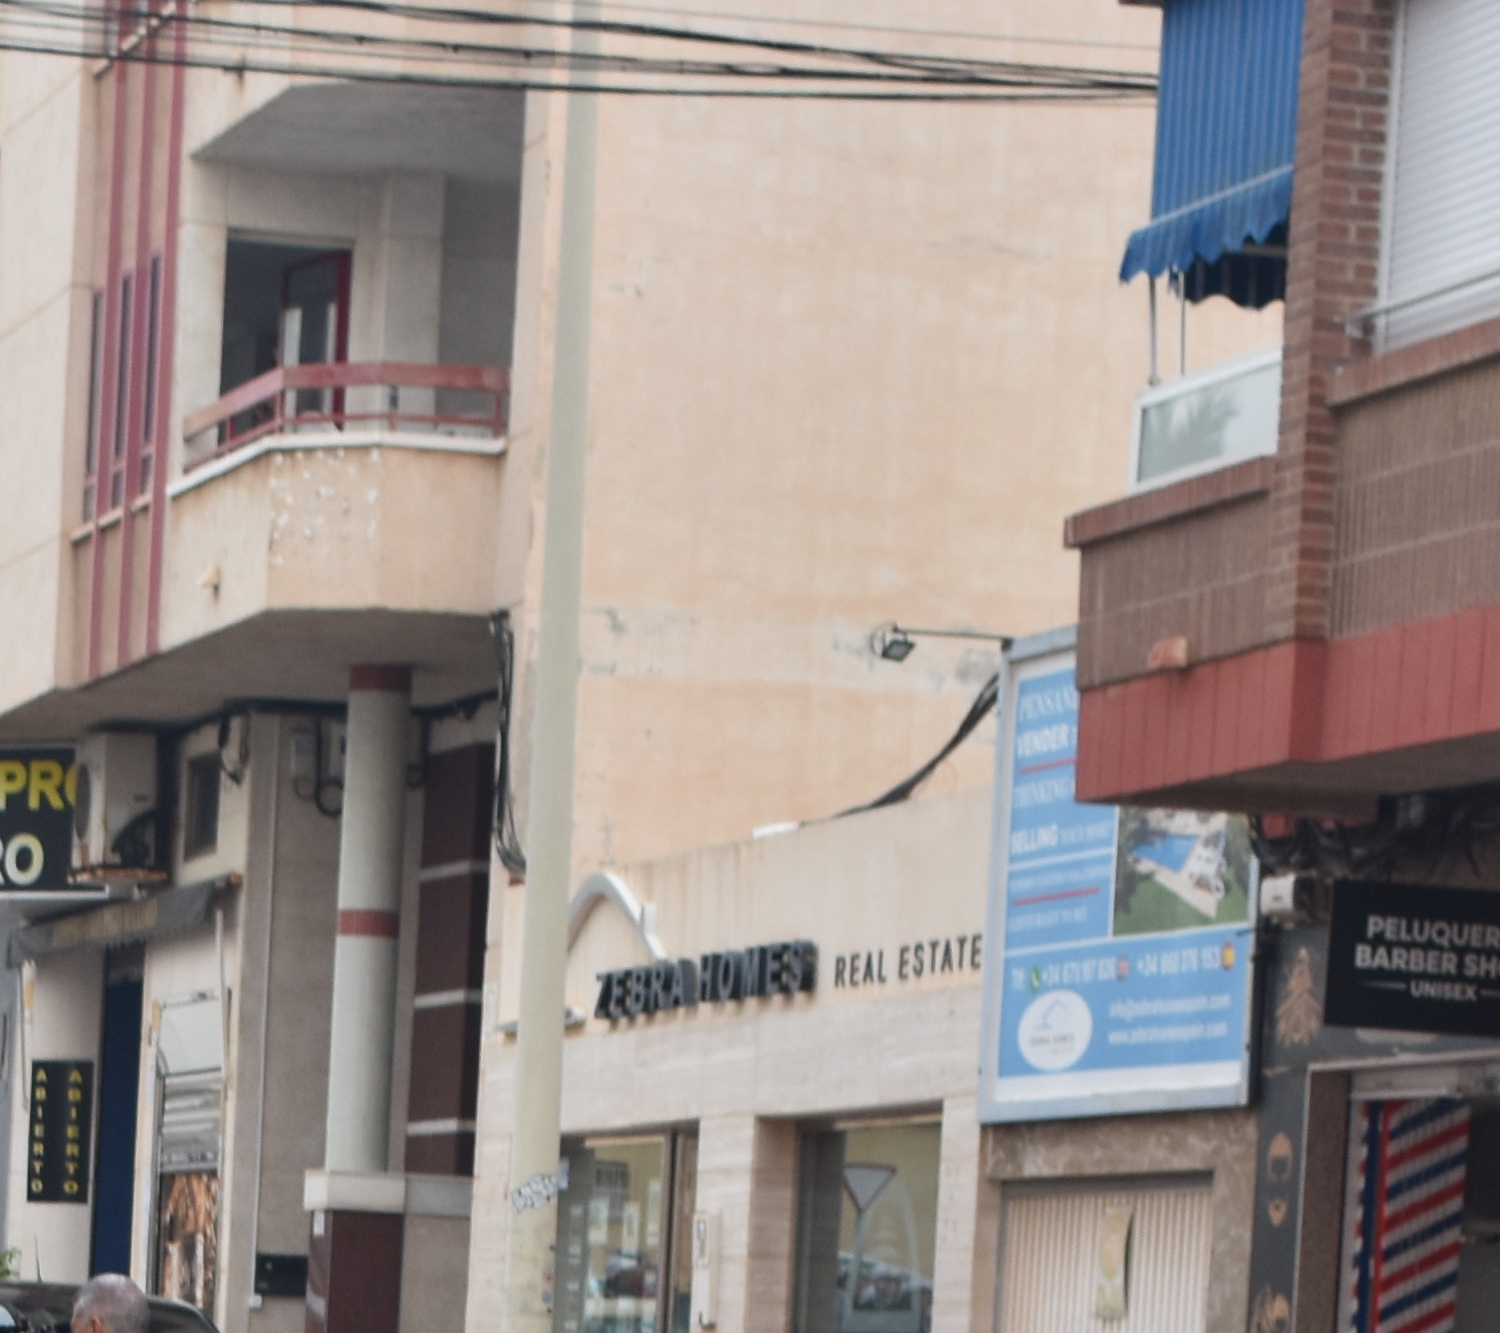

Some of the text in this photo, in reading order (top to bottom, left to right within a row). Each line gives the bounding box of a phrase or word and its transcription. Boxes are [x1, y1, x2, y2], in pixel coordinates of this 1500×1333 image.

[594, 933, 983, 1020] ZEBRA HOMES REAL ESTATE
[1355, 943, 1458, 976] BARBER
[1409, 979, 1477, 1001] UNISEX
[31, 1068, 48, 1194] ABIERTO
[63, 1069, 83, 1195] ABIERTO
